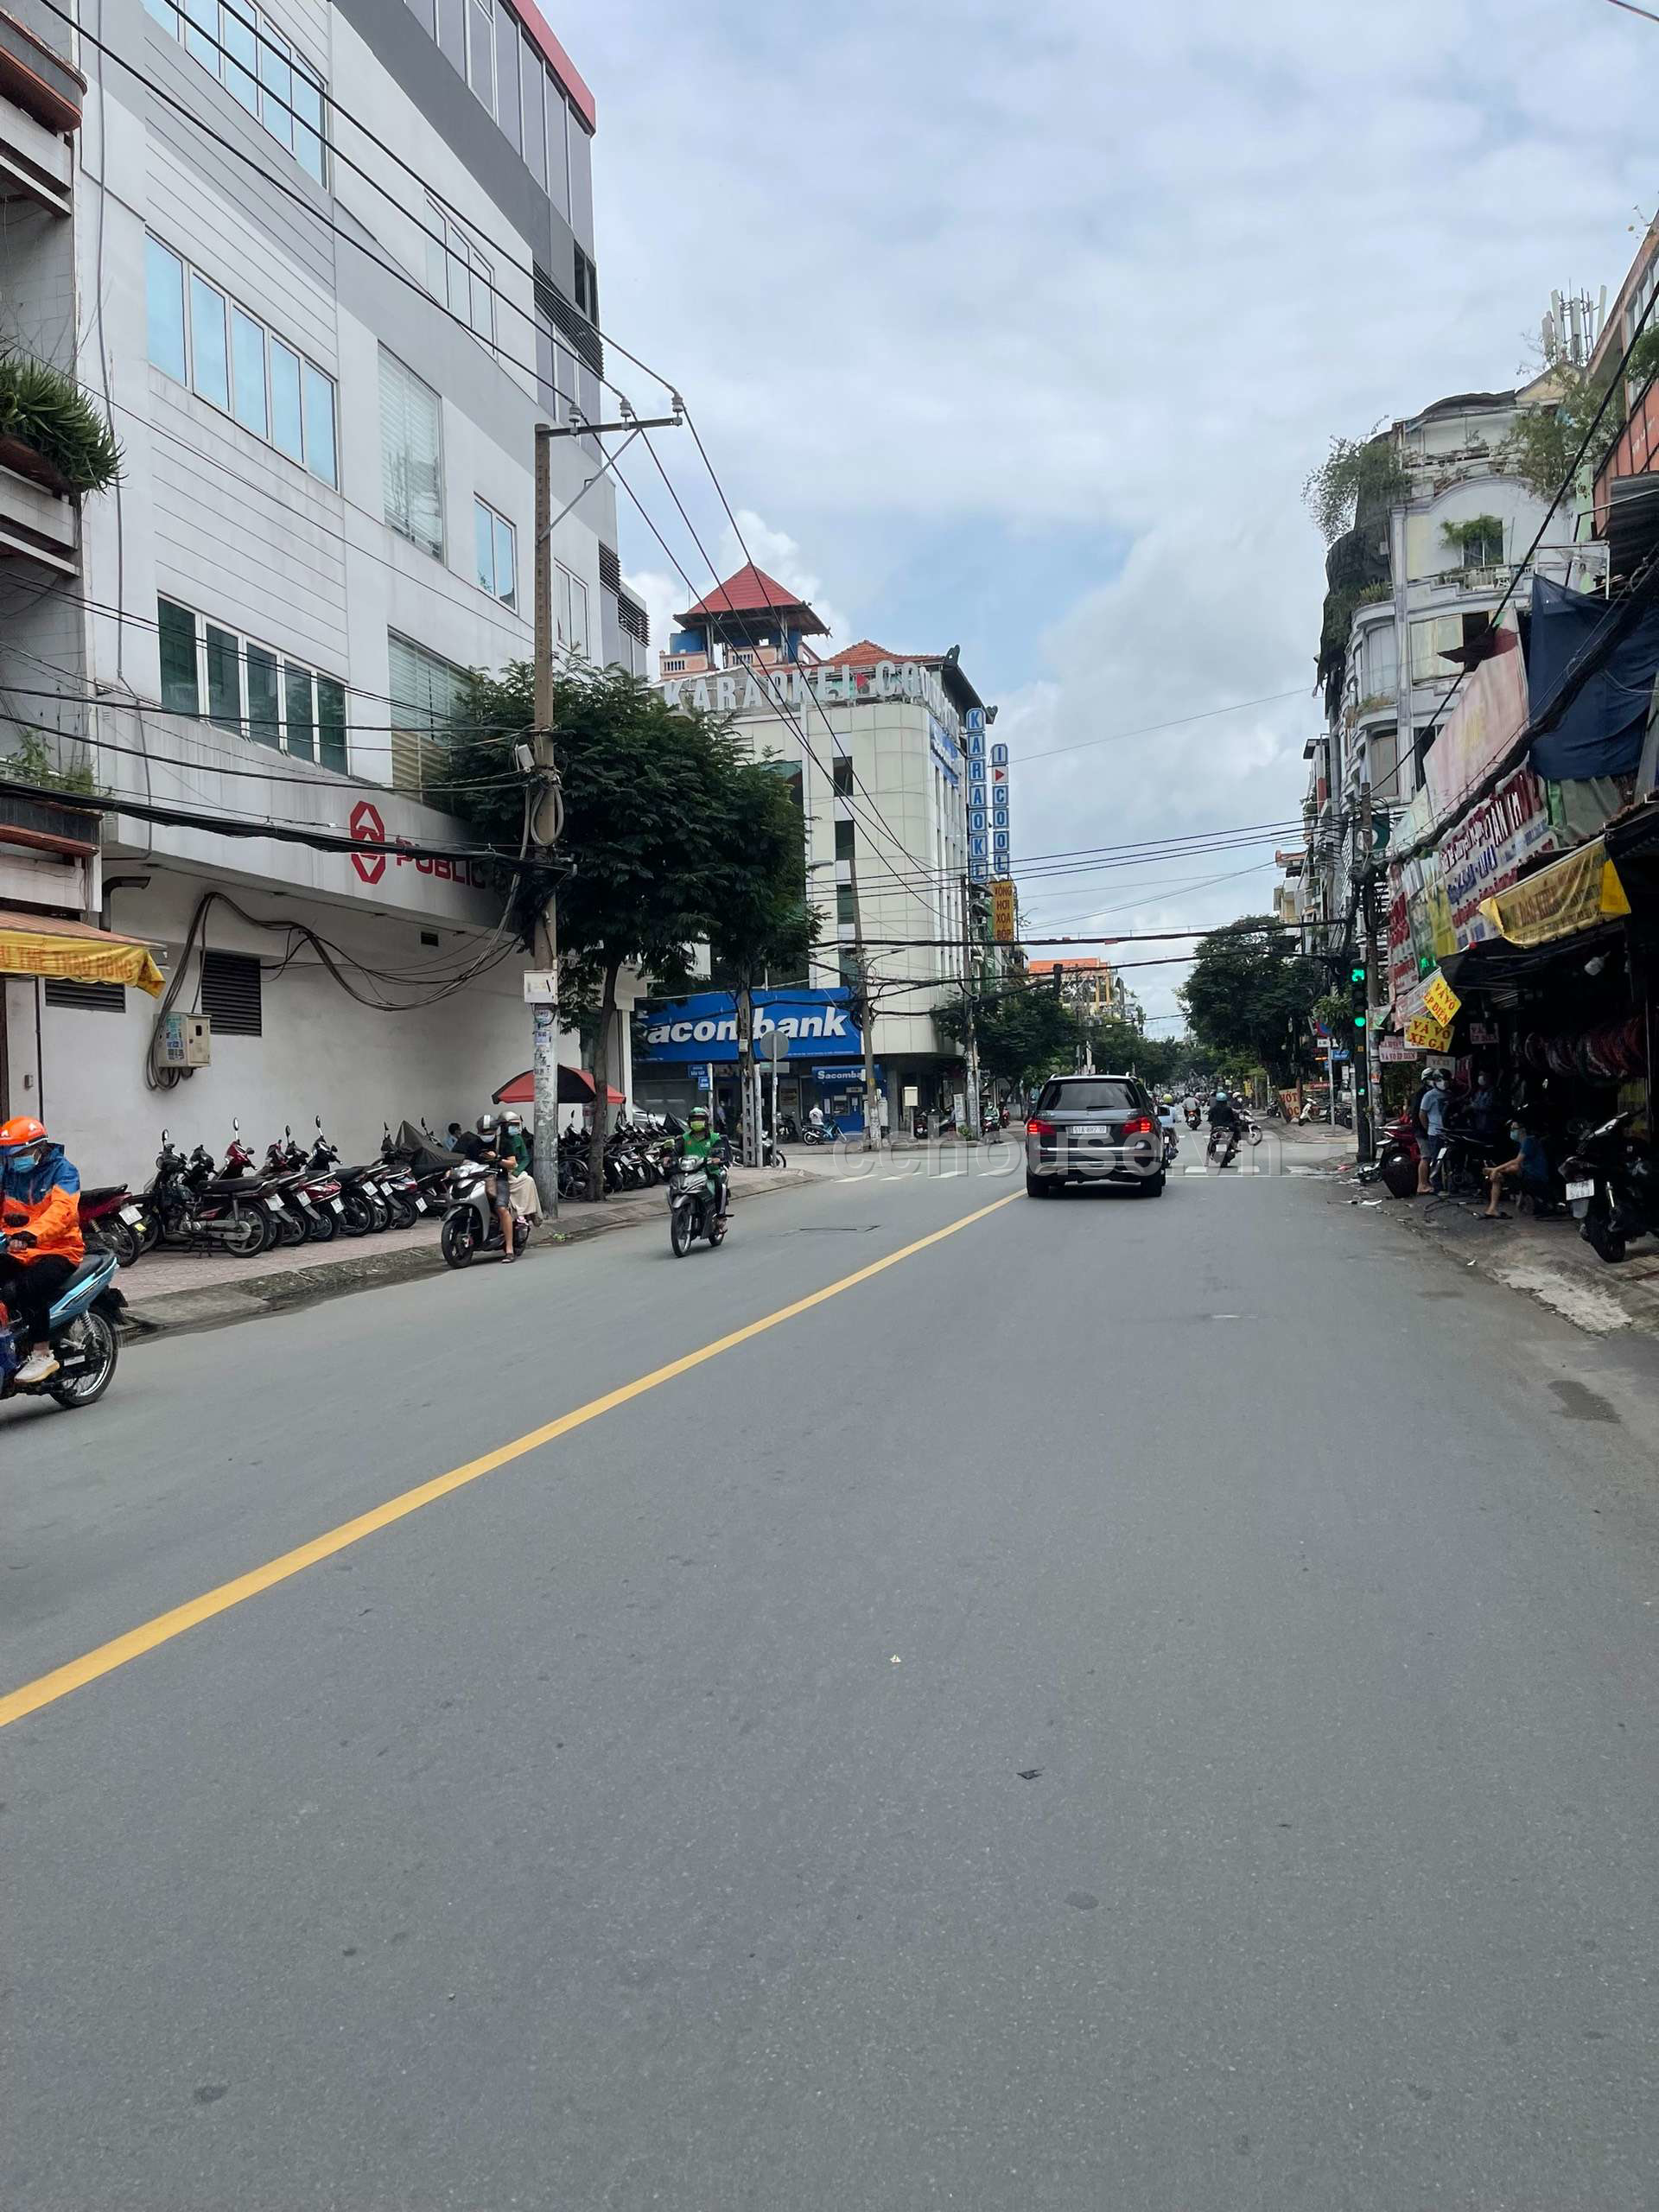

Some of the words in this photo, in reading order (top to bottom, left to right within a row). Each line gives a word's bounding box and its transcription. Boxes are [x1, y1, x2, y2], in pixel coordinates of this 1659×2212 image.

[664, 666, 835, 710] KARAOKE
[969, 711, 985, 880] KARAOKE
[995, 787, 1007, 872] COOL
[640, 1006, 849, 1046] acombank
[817, 1070, 863, 1080] Sacomba
